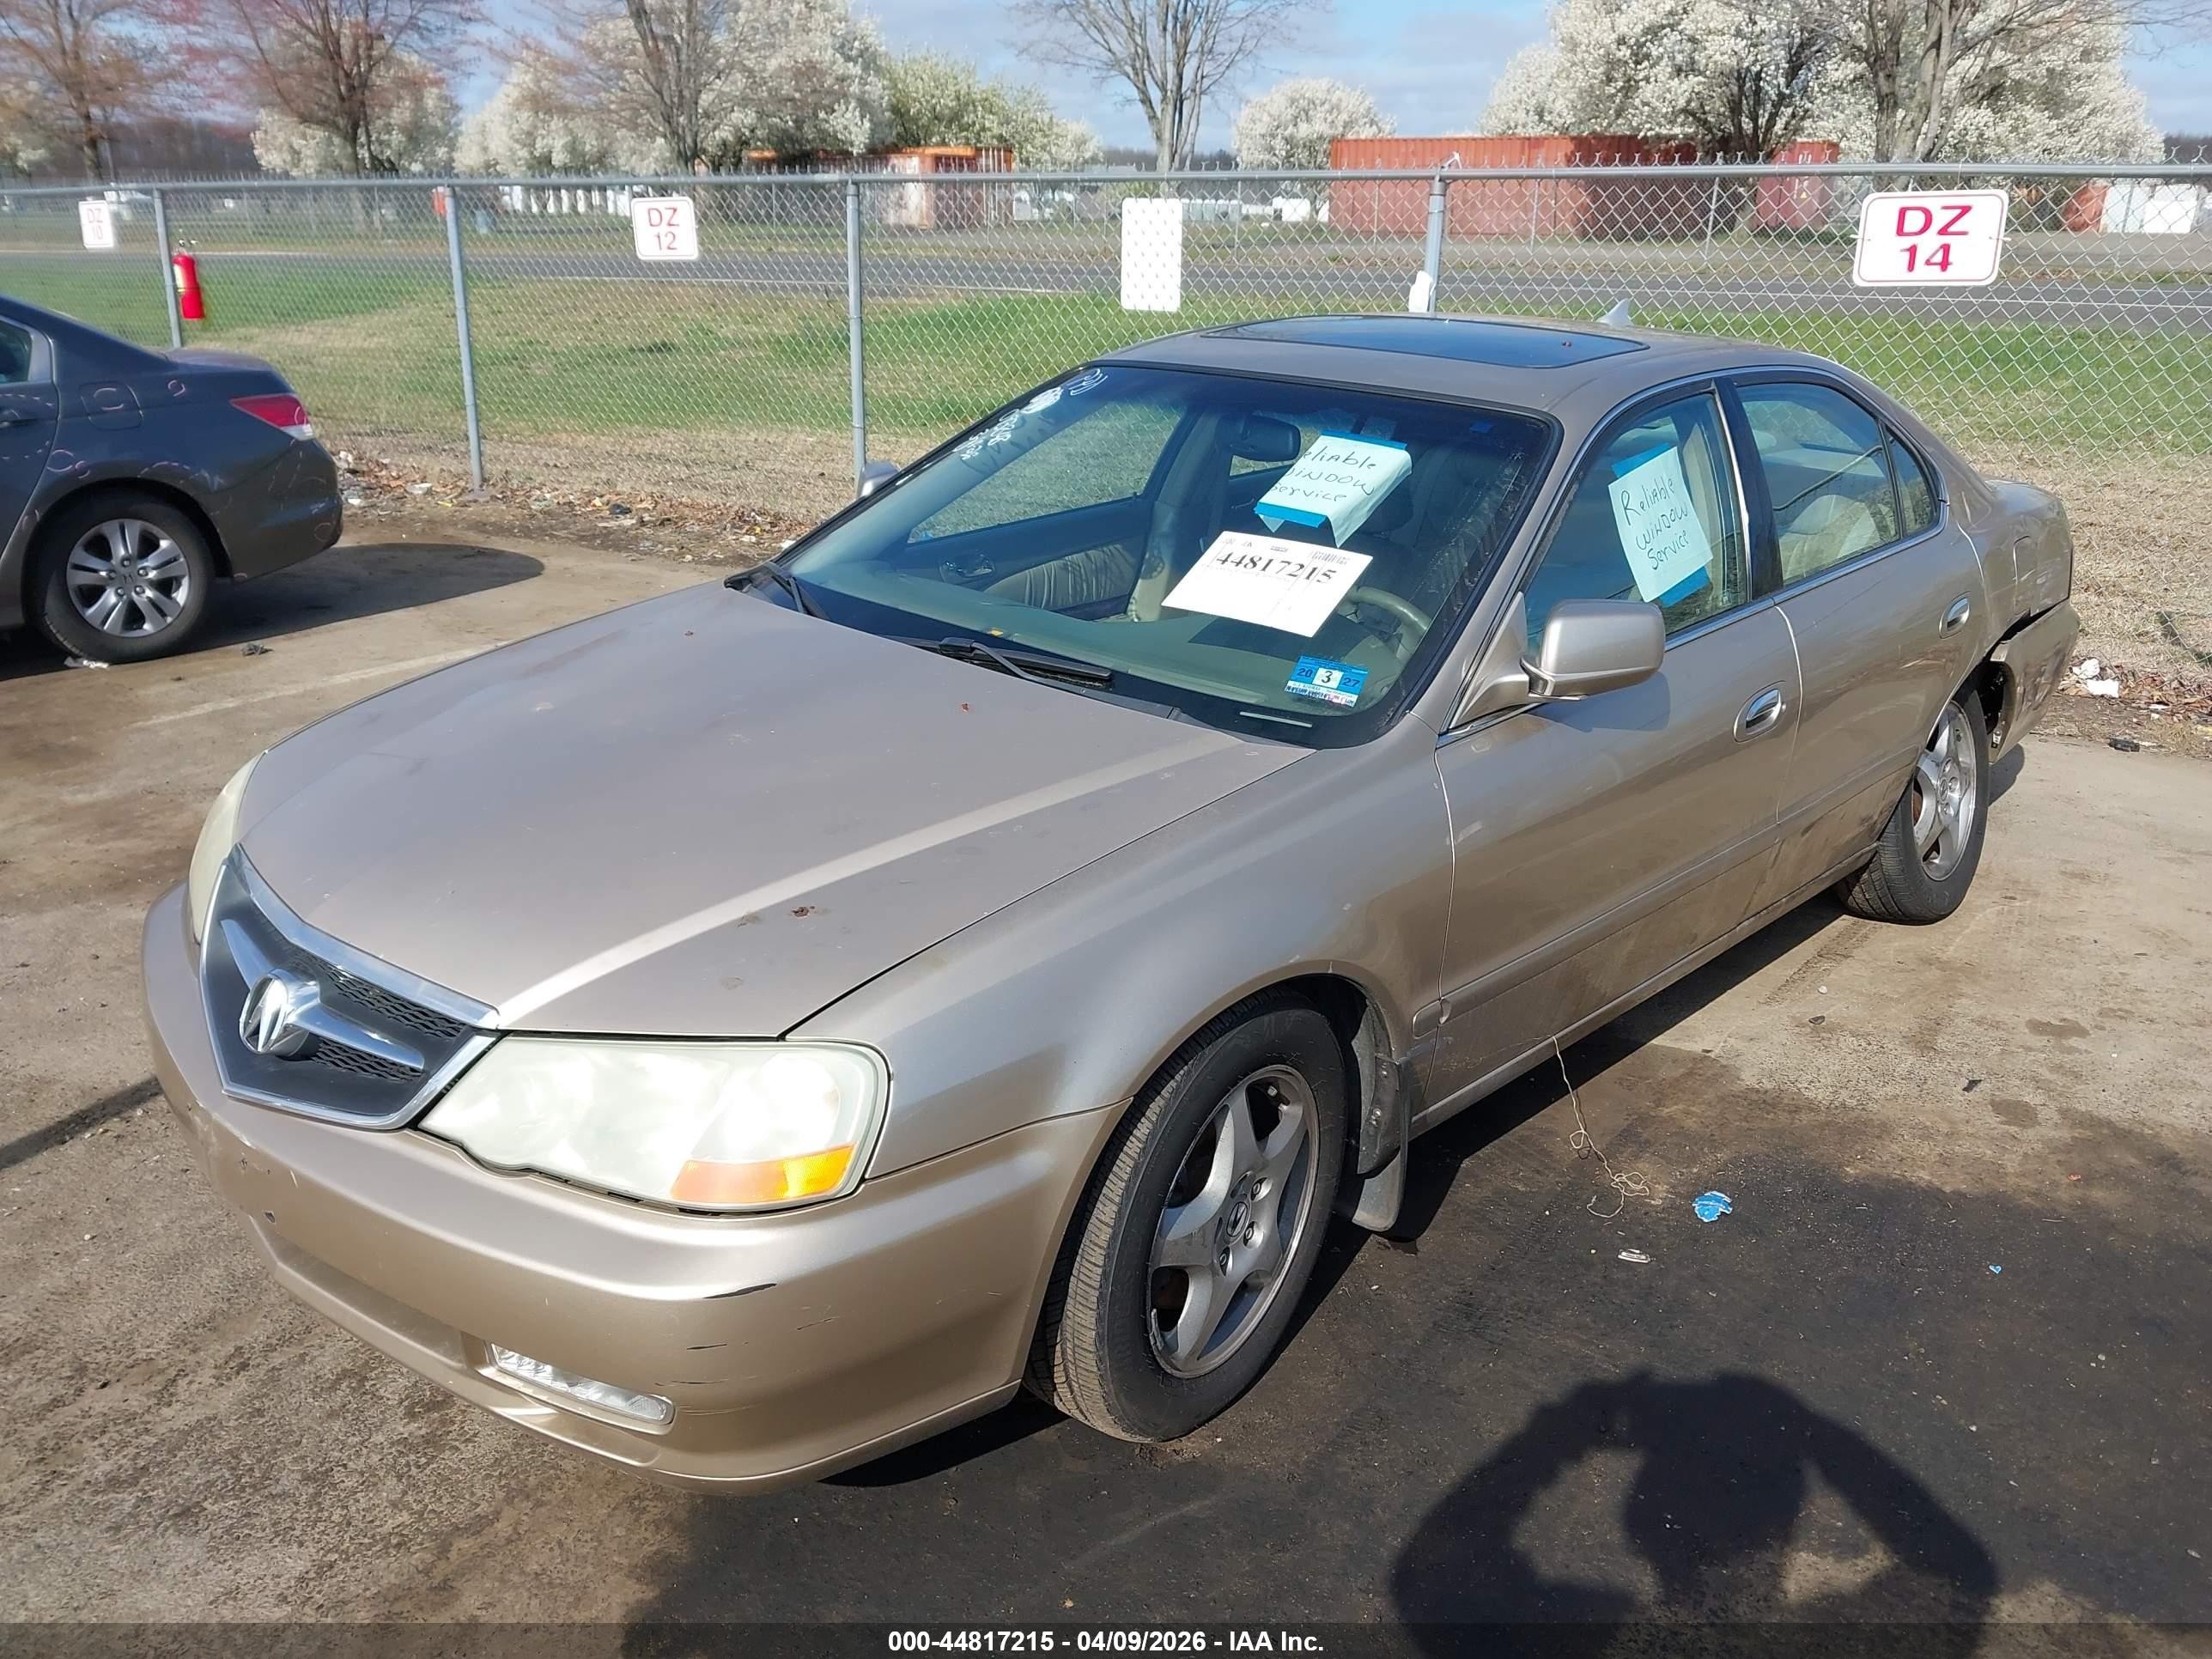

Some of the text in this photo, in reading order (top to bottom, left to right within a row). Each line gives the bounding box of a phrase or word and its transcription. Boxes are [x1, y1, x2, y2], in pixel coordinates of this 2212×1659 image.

[87, 208, 104, 223] DZ
[647, 207, 680, 227] DZ
[1895, 205, 1973, 237] DZ
[653, 231, 678, 251] 12
[1899, 243, 1954, 272] 14
[1216, 550, 1338, 584] 44817215
[1297, 668, 1361, 688] 20 3 27
